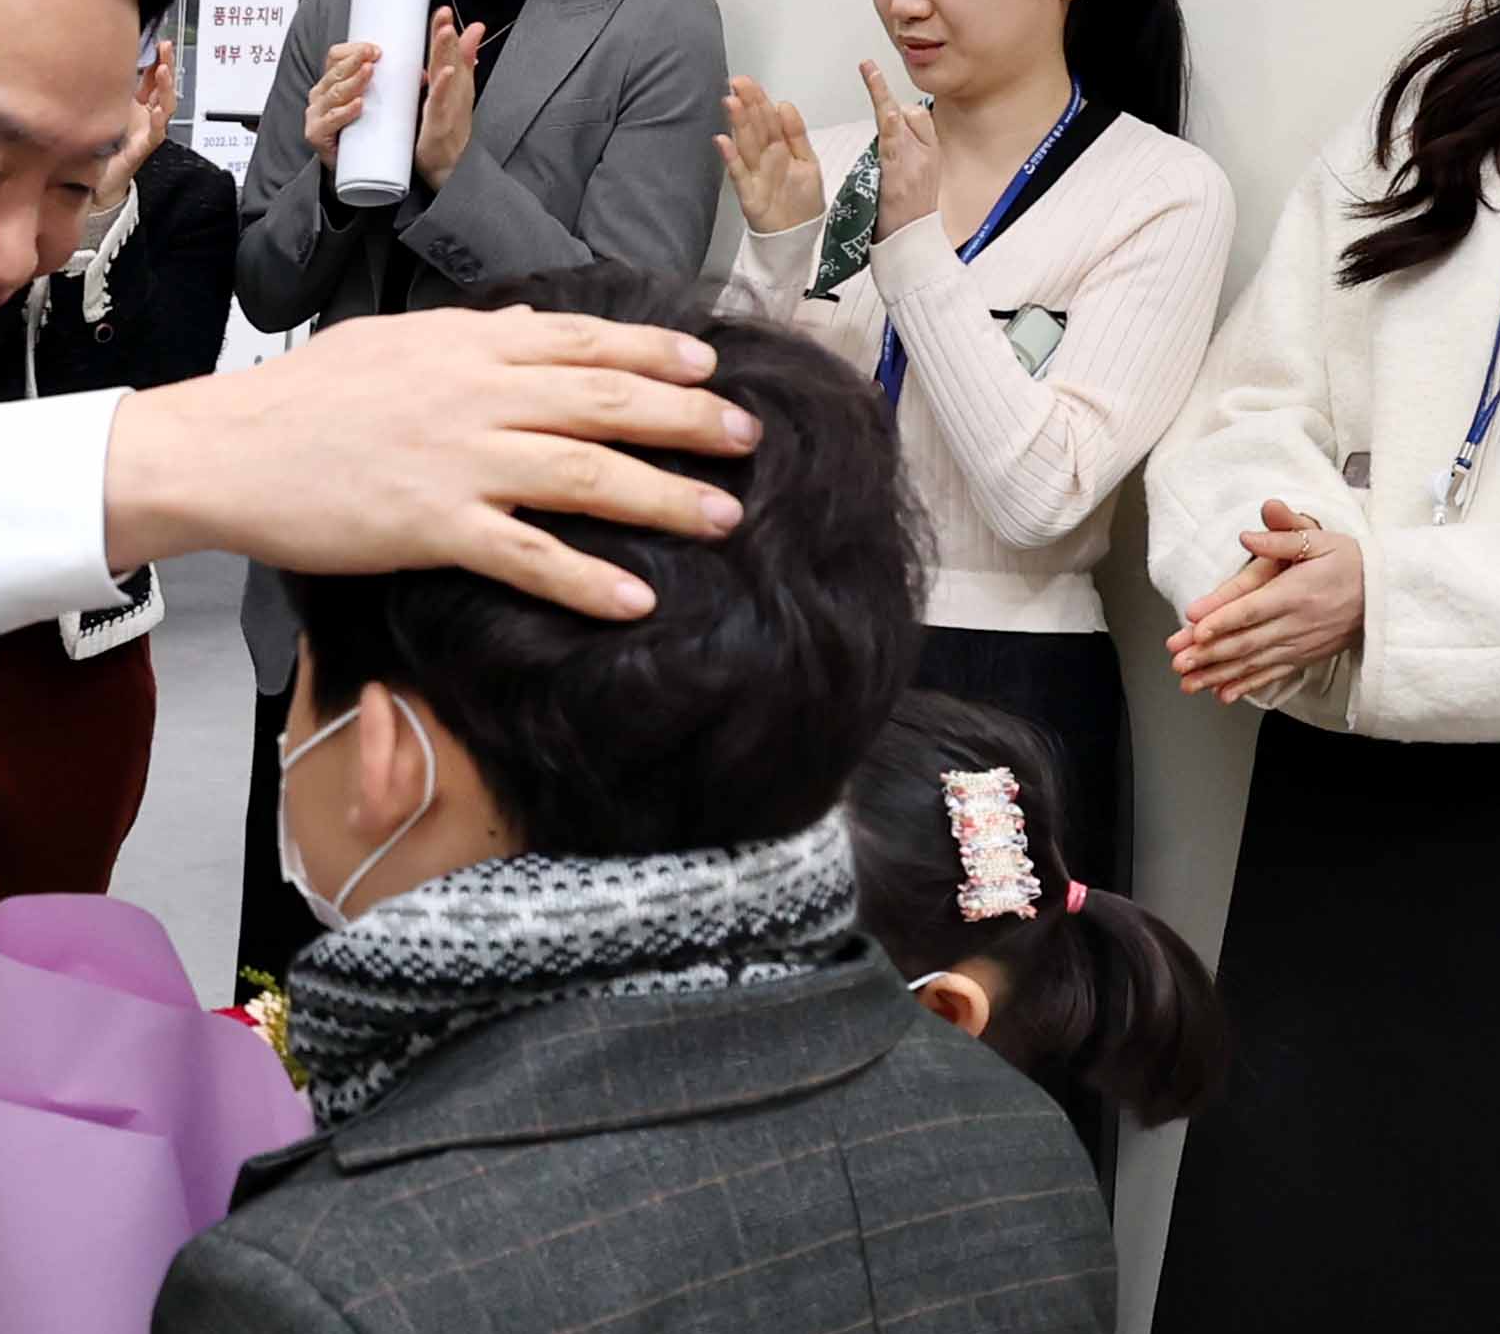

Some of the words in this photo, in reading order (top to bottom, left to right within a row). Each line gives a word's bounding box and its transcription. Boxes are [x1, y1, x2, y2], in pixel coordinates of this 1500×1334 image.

[213, 6, 284, 27] 품위유지비
[214, 44, 241, 65] 배부
[249, 44, 278, 65] 장소
